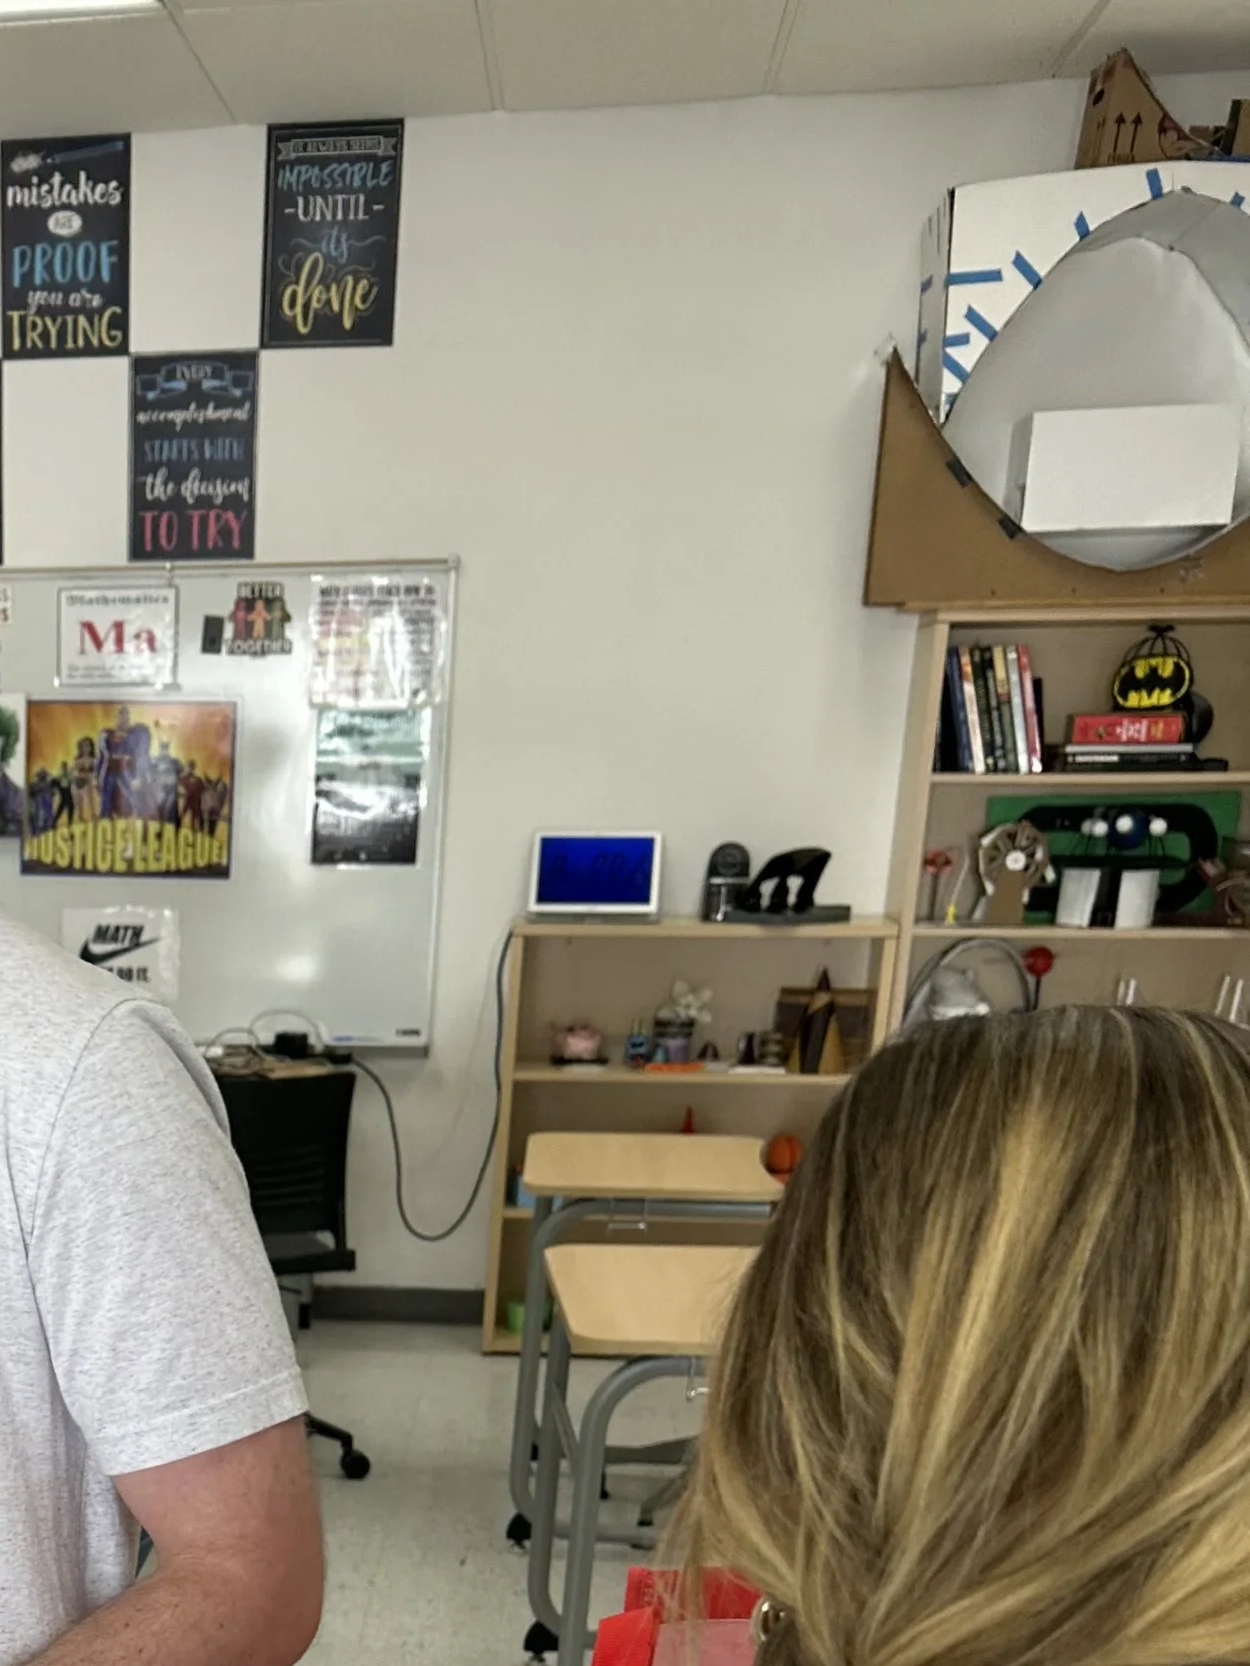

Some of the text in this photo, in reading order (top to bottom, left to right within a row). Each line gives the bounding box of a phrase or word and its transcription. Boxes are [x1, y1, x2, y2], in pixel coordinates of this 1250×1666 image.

[6, 170, 124, 209] mistakes
[277, 160, 394, 193] IMPOSSIBLE
[12, 240, 118, 288] PROOF
[27, 290, 63, 315] you
[282, 251, 379, 335] done
[6, 306, 123, 350] TRYING
[138, 466, 250, 506] the decision
[139, 508, 248, 552] TO TRY
[78, 619, 157, 655] Ma
[92, 924, 144, 946] MATH
